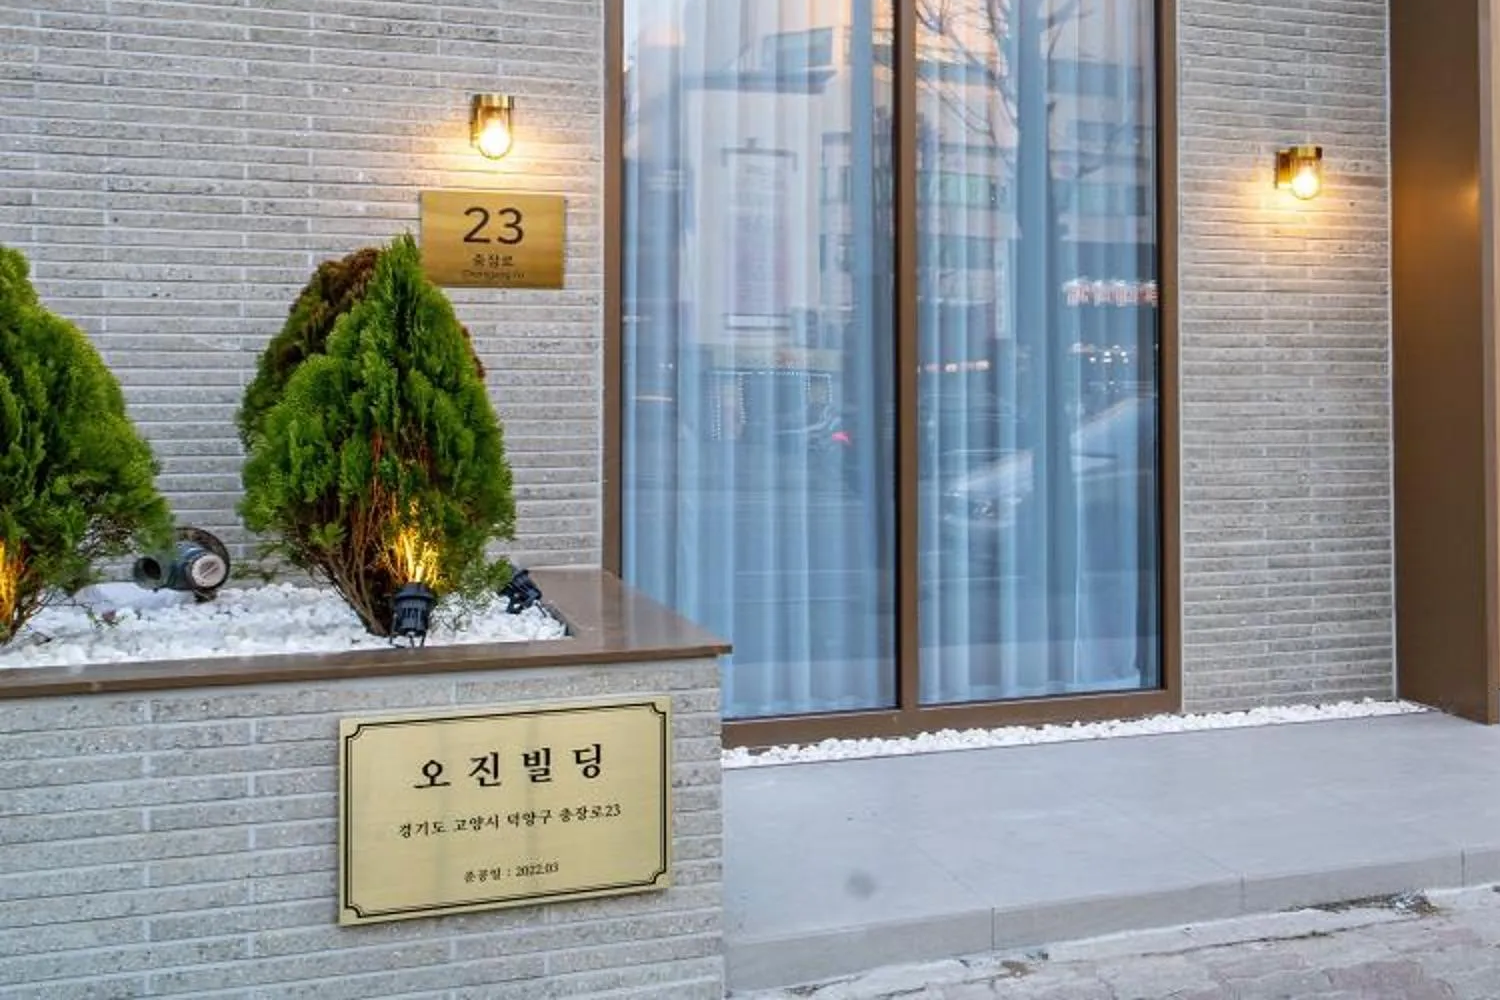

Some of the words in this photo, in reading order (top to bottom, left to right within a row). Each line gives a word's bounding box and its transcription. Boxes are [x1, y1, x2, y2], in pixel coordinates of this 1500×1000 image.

[463, 206, 524, 244] 23
[399, 821, 448, 840] 경기도
[453, 814, 499, 831] 고양시
